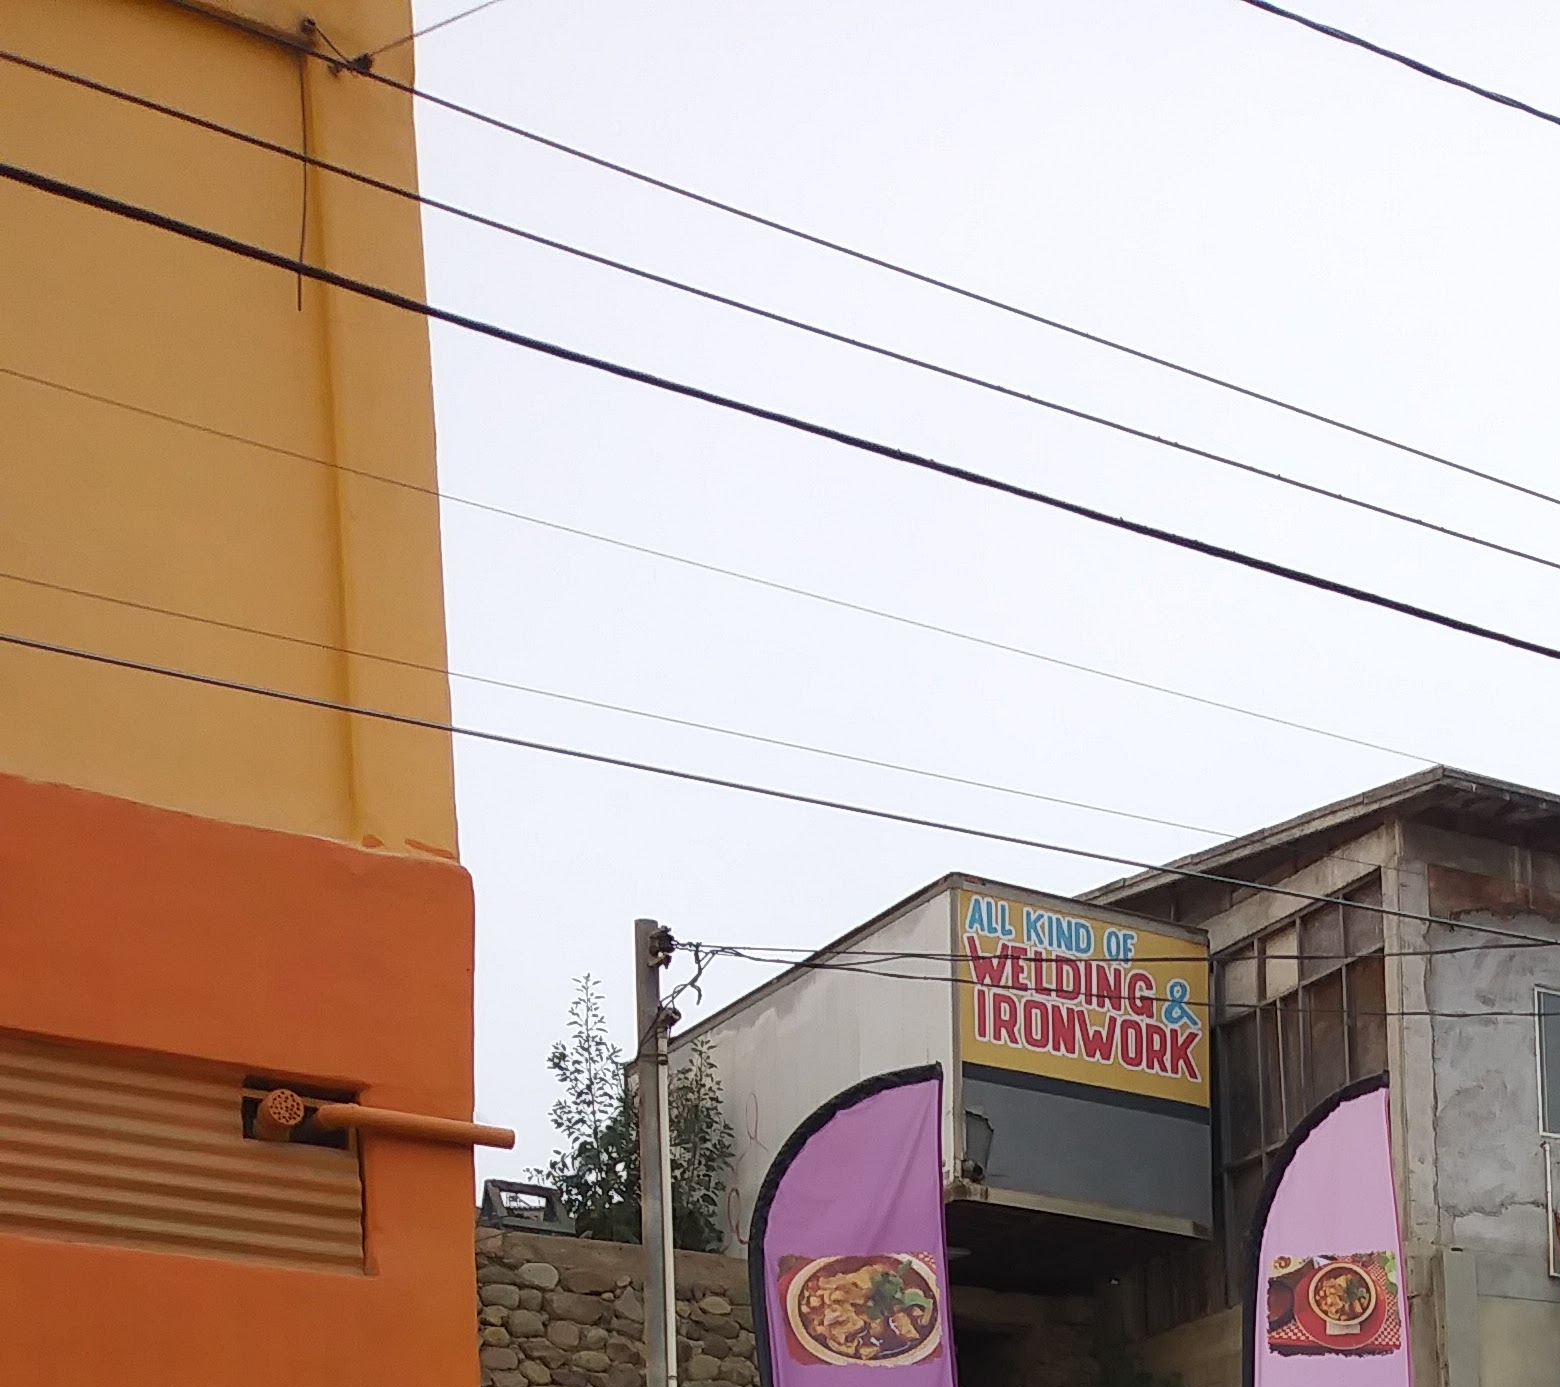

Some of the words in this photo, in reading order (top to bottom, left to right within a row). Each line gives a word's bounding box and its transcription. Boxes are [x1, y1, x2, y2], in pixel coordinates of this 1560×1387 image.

[967, 898, 1013, 936] ALL
[1025, 909, 1092, 955] KIND
[1106, 930, 1136, 966] OF
[966, 935, 1155, 1020] WELDING
[1164, 981, 1199, 1027] &
[976, 988, 1199, 1081] IRONWORK
